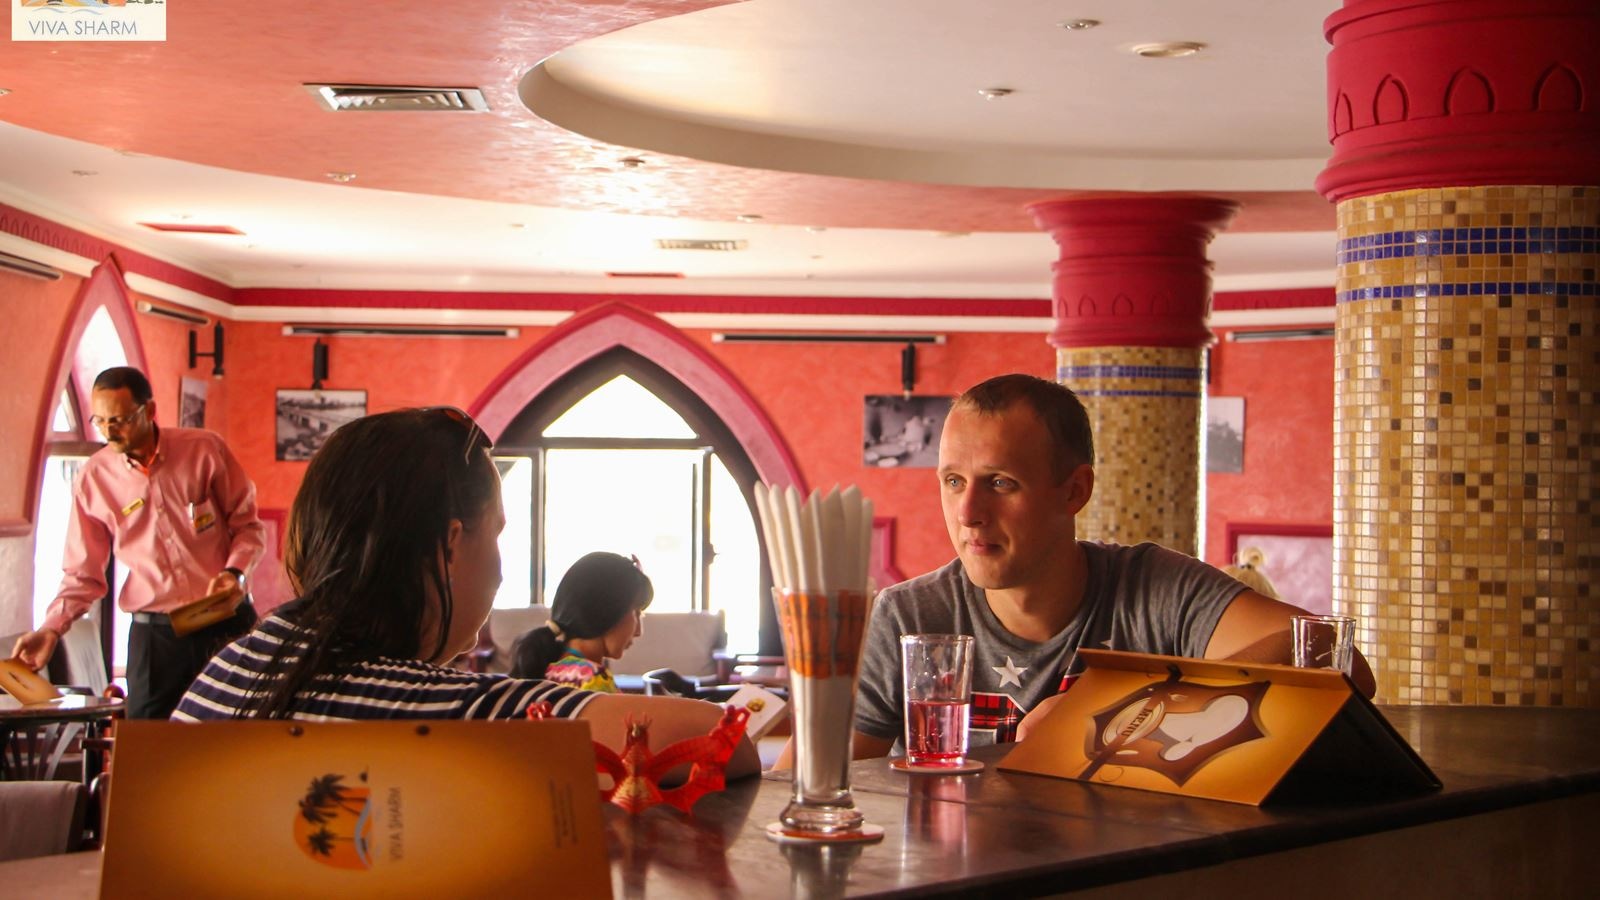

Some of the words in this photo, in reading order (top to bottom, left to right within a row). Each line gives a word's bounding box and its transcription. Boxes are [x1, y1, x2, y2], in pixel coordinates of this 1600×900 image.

[1121, 706, 1153, 737] MENU
[388, 786, 403, 829] SHARM
[389, 832, 404, 862] VIVA
